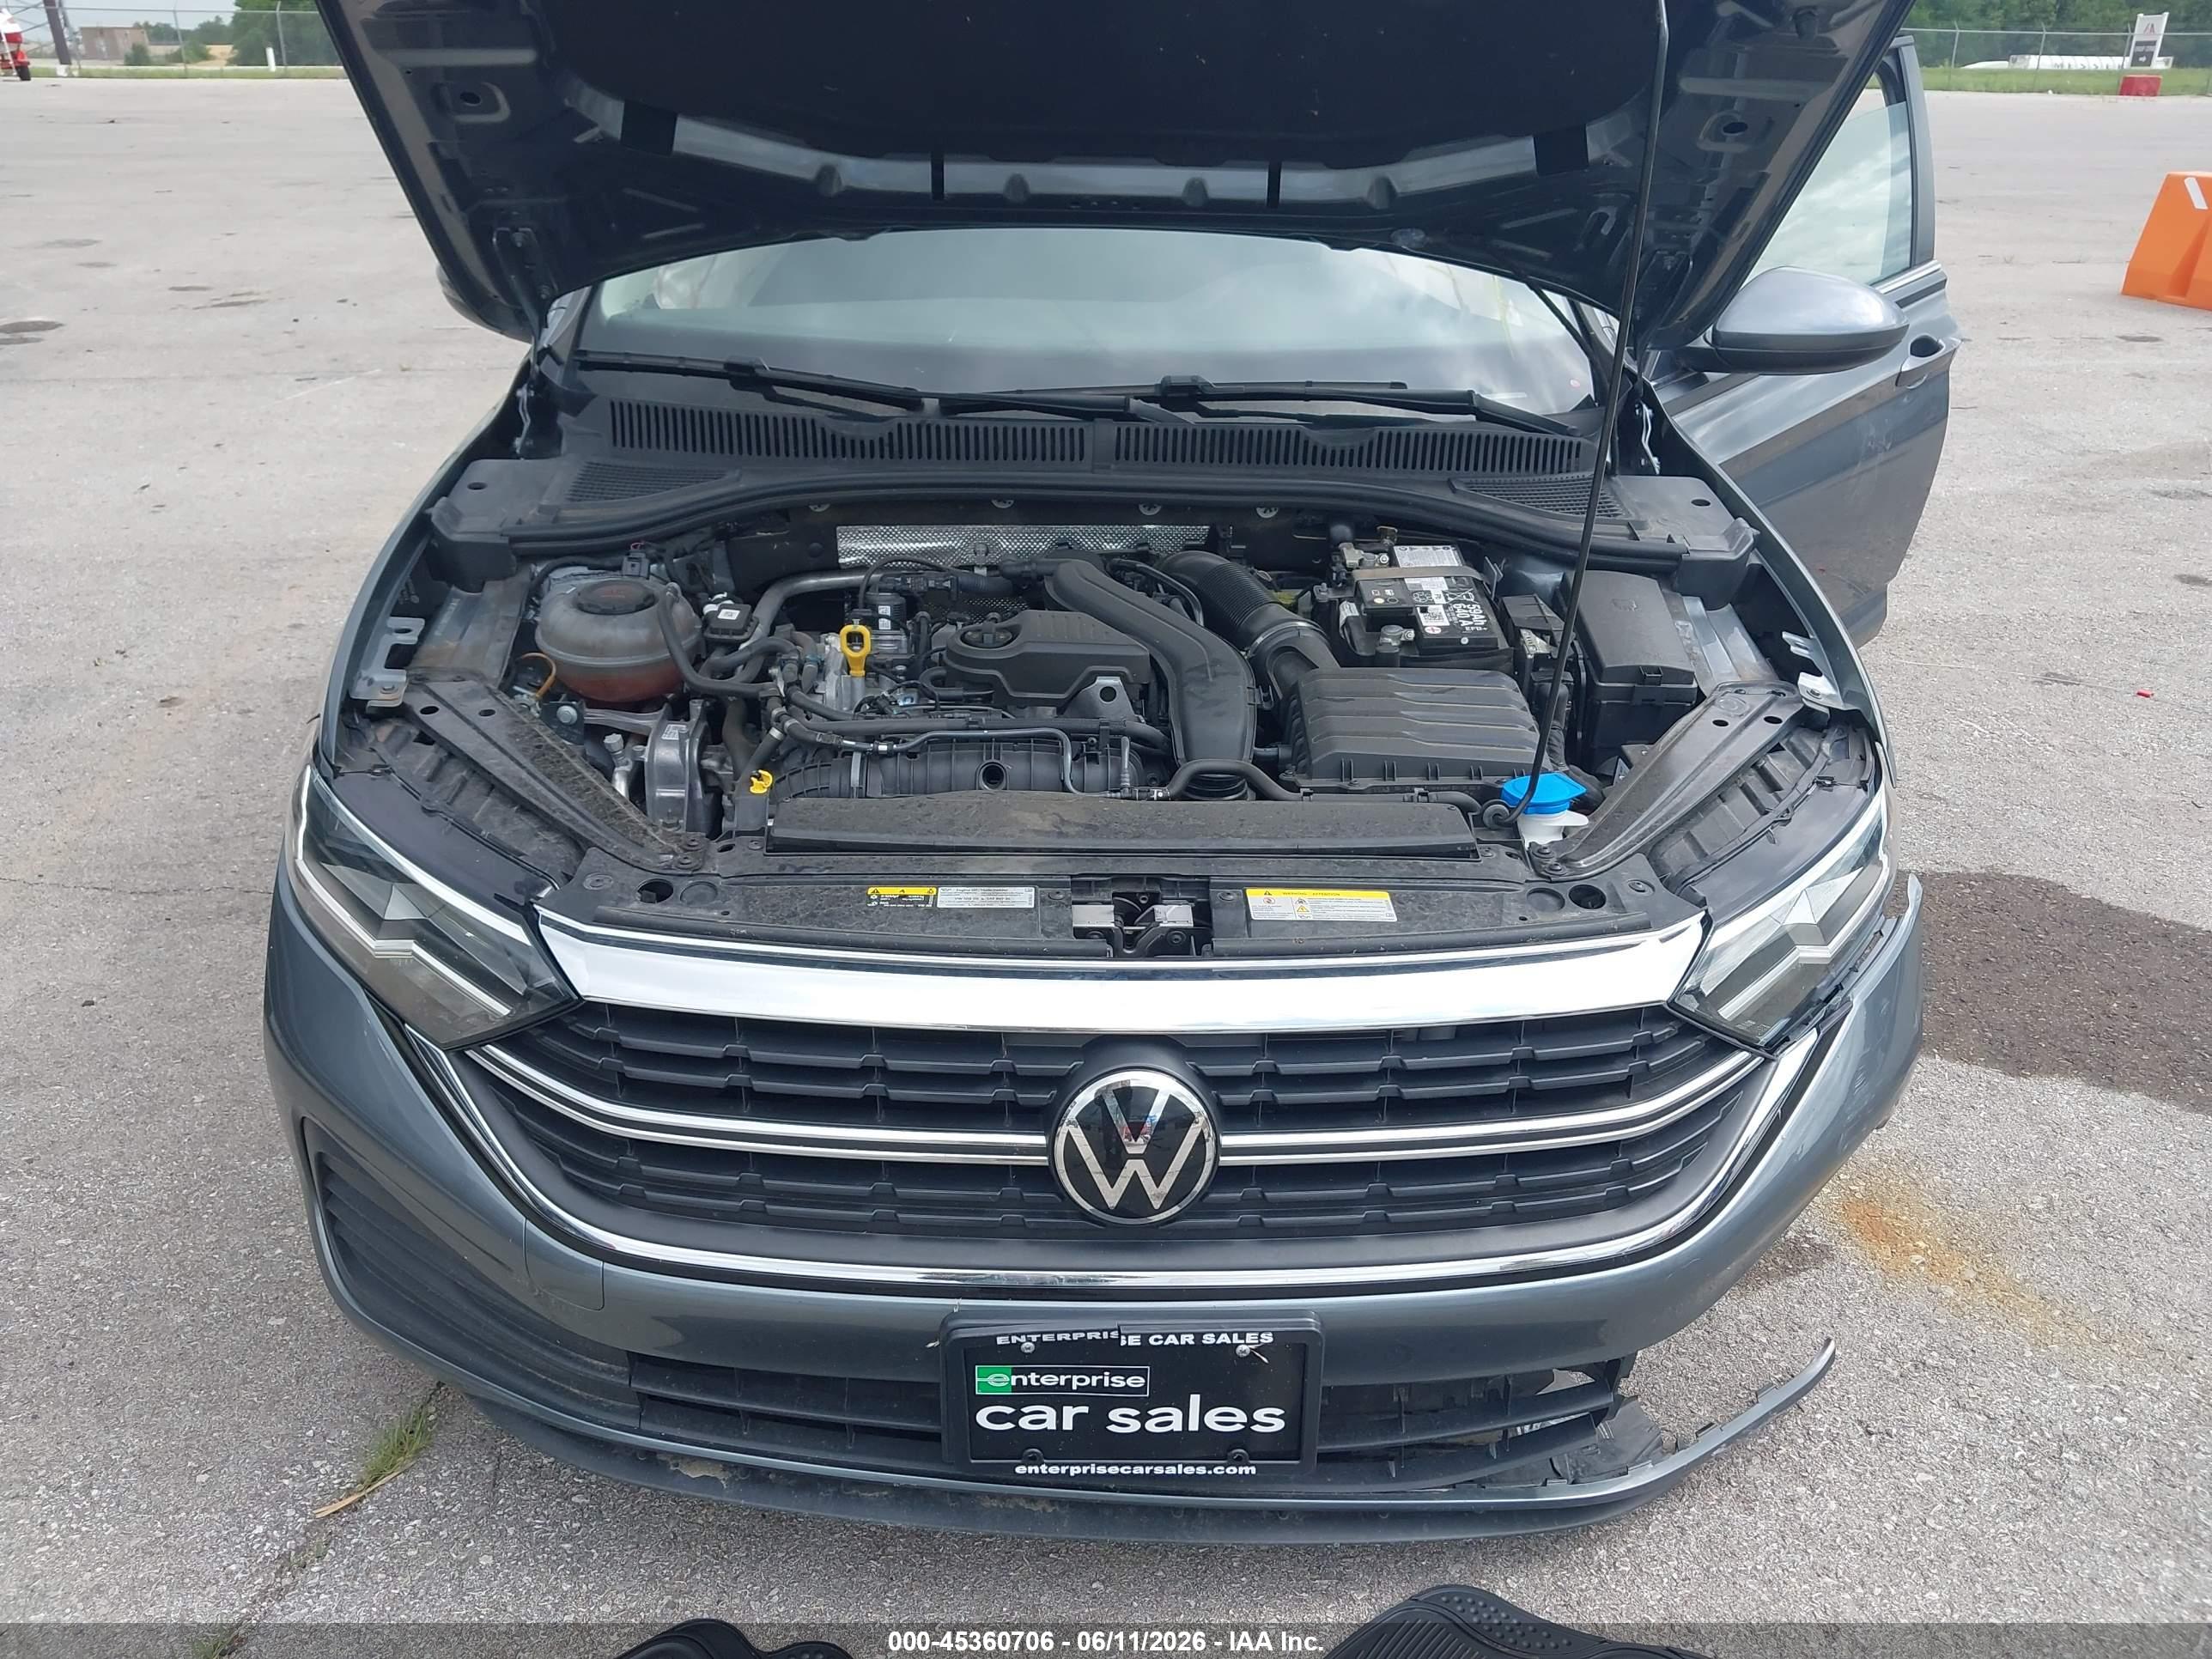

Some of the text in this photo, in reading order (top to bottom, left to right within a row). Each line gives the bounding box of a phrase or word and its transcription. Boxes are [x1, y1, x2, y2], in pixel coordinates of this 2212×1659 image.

[1453, 603, 1471, 618] 640
[1467, 604, 1487, 625] 59Ah
[1148, 1334, 1195, 1346] CAR
[1202, 1331, 1274, 1346] SALES
[987, 1371, 1146, 1390] enterprise
[975, 1394, 1285, 1433] car sales
[1014, 1463, 1257, 1476] enterprisecarsales.com
